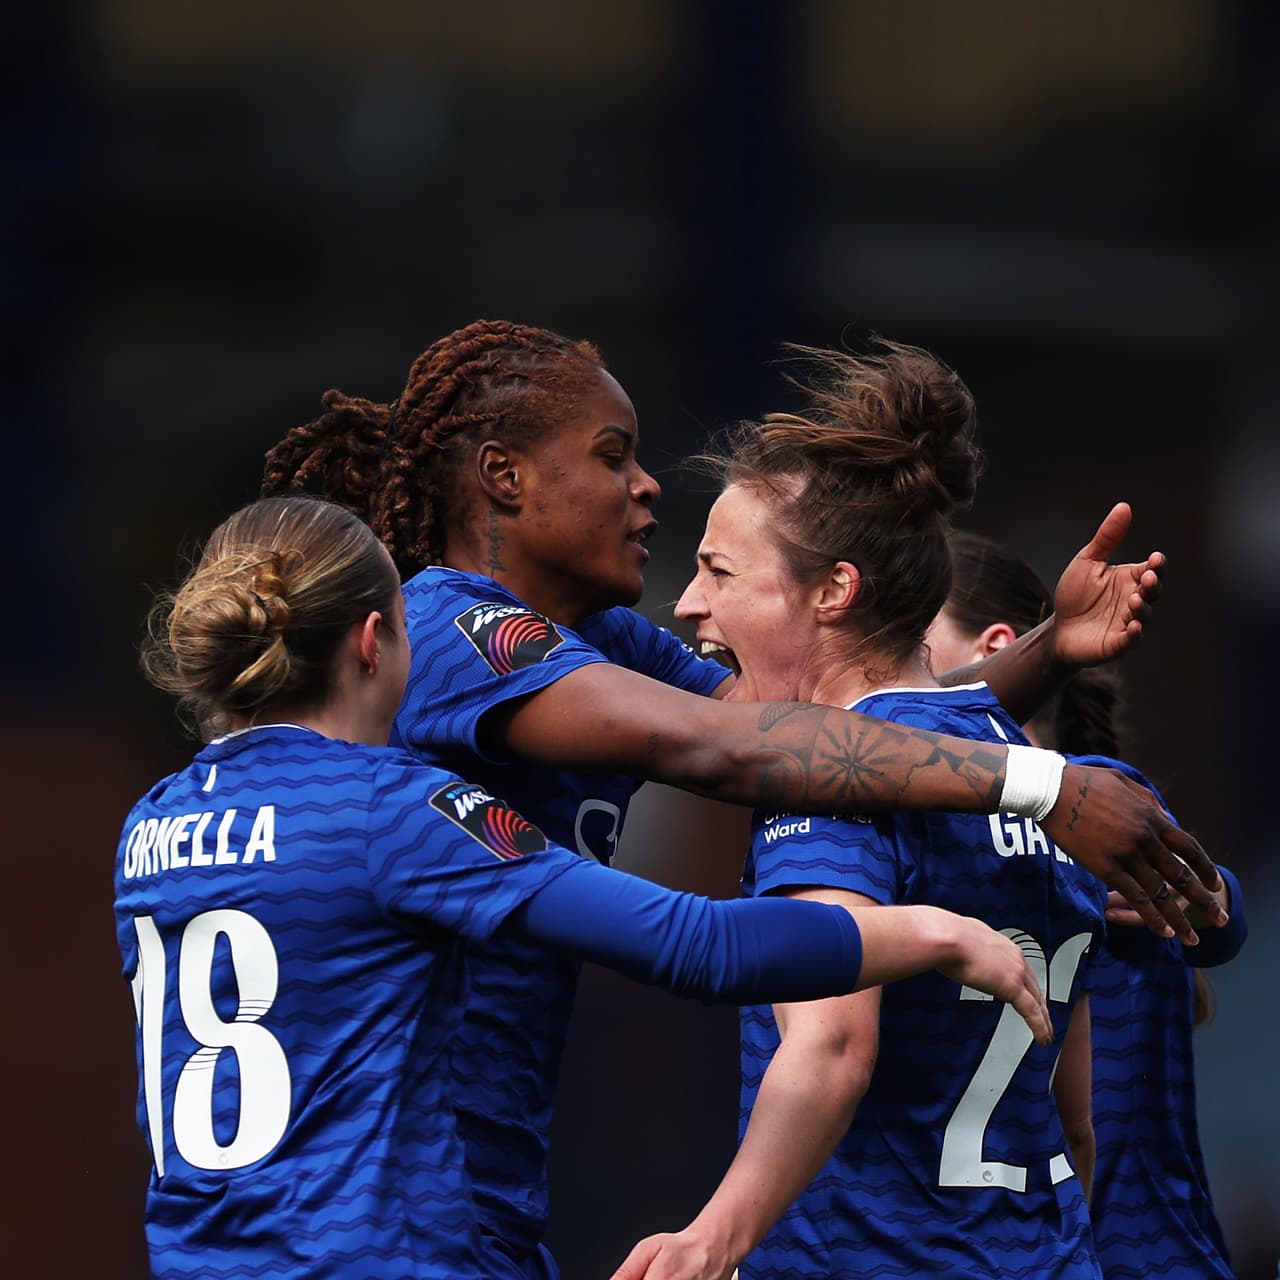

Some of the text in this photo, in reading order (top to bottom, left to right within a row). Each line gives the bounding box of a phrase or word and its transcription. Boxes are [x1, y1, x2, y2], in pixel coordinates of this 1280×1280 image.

[123, 804, 277, 880] ORNELLA
[764, 818, 810, 843] Ward
[130, 908, 292, 1178] 18
